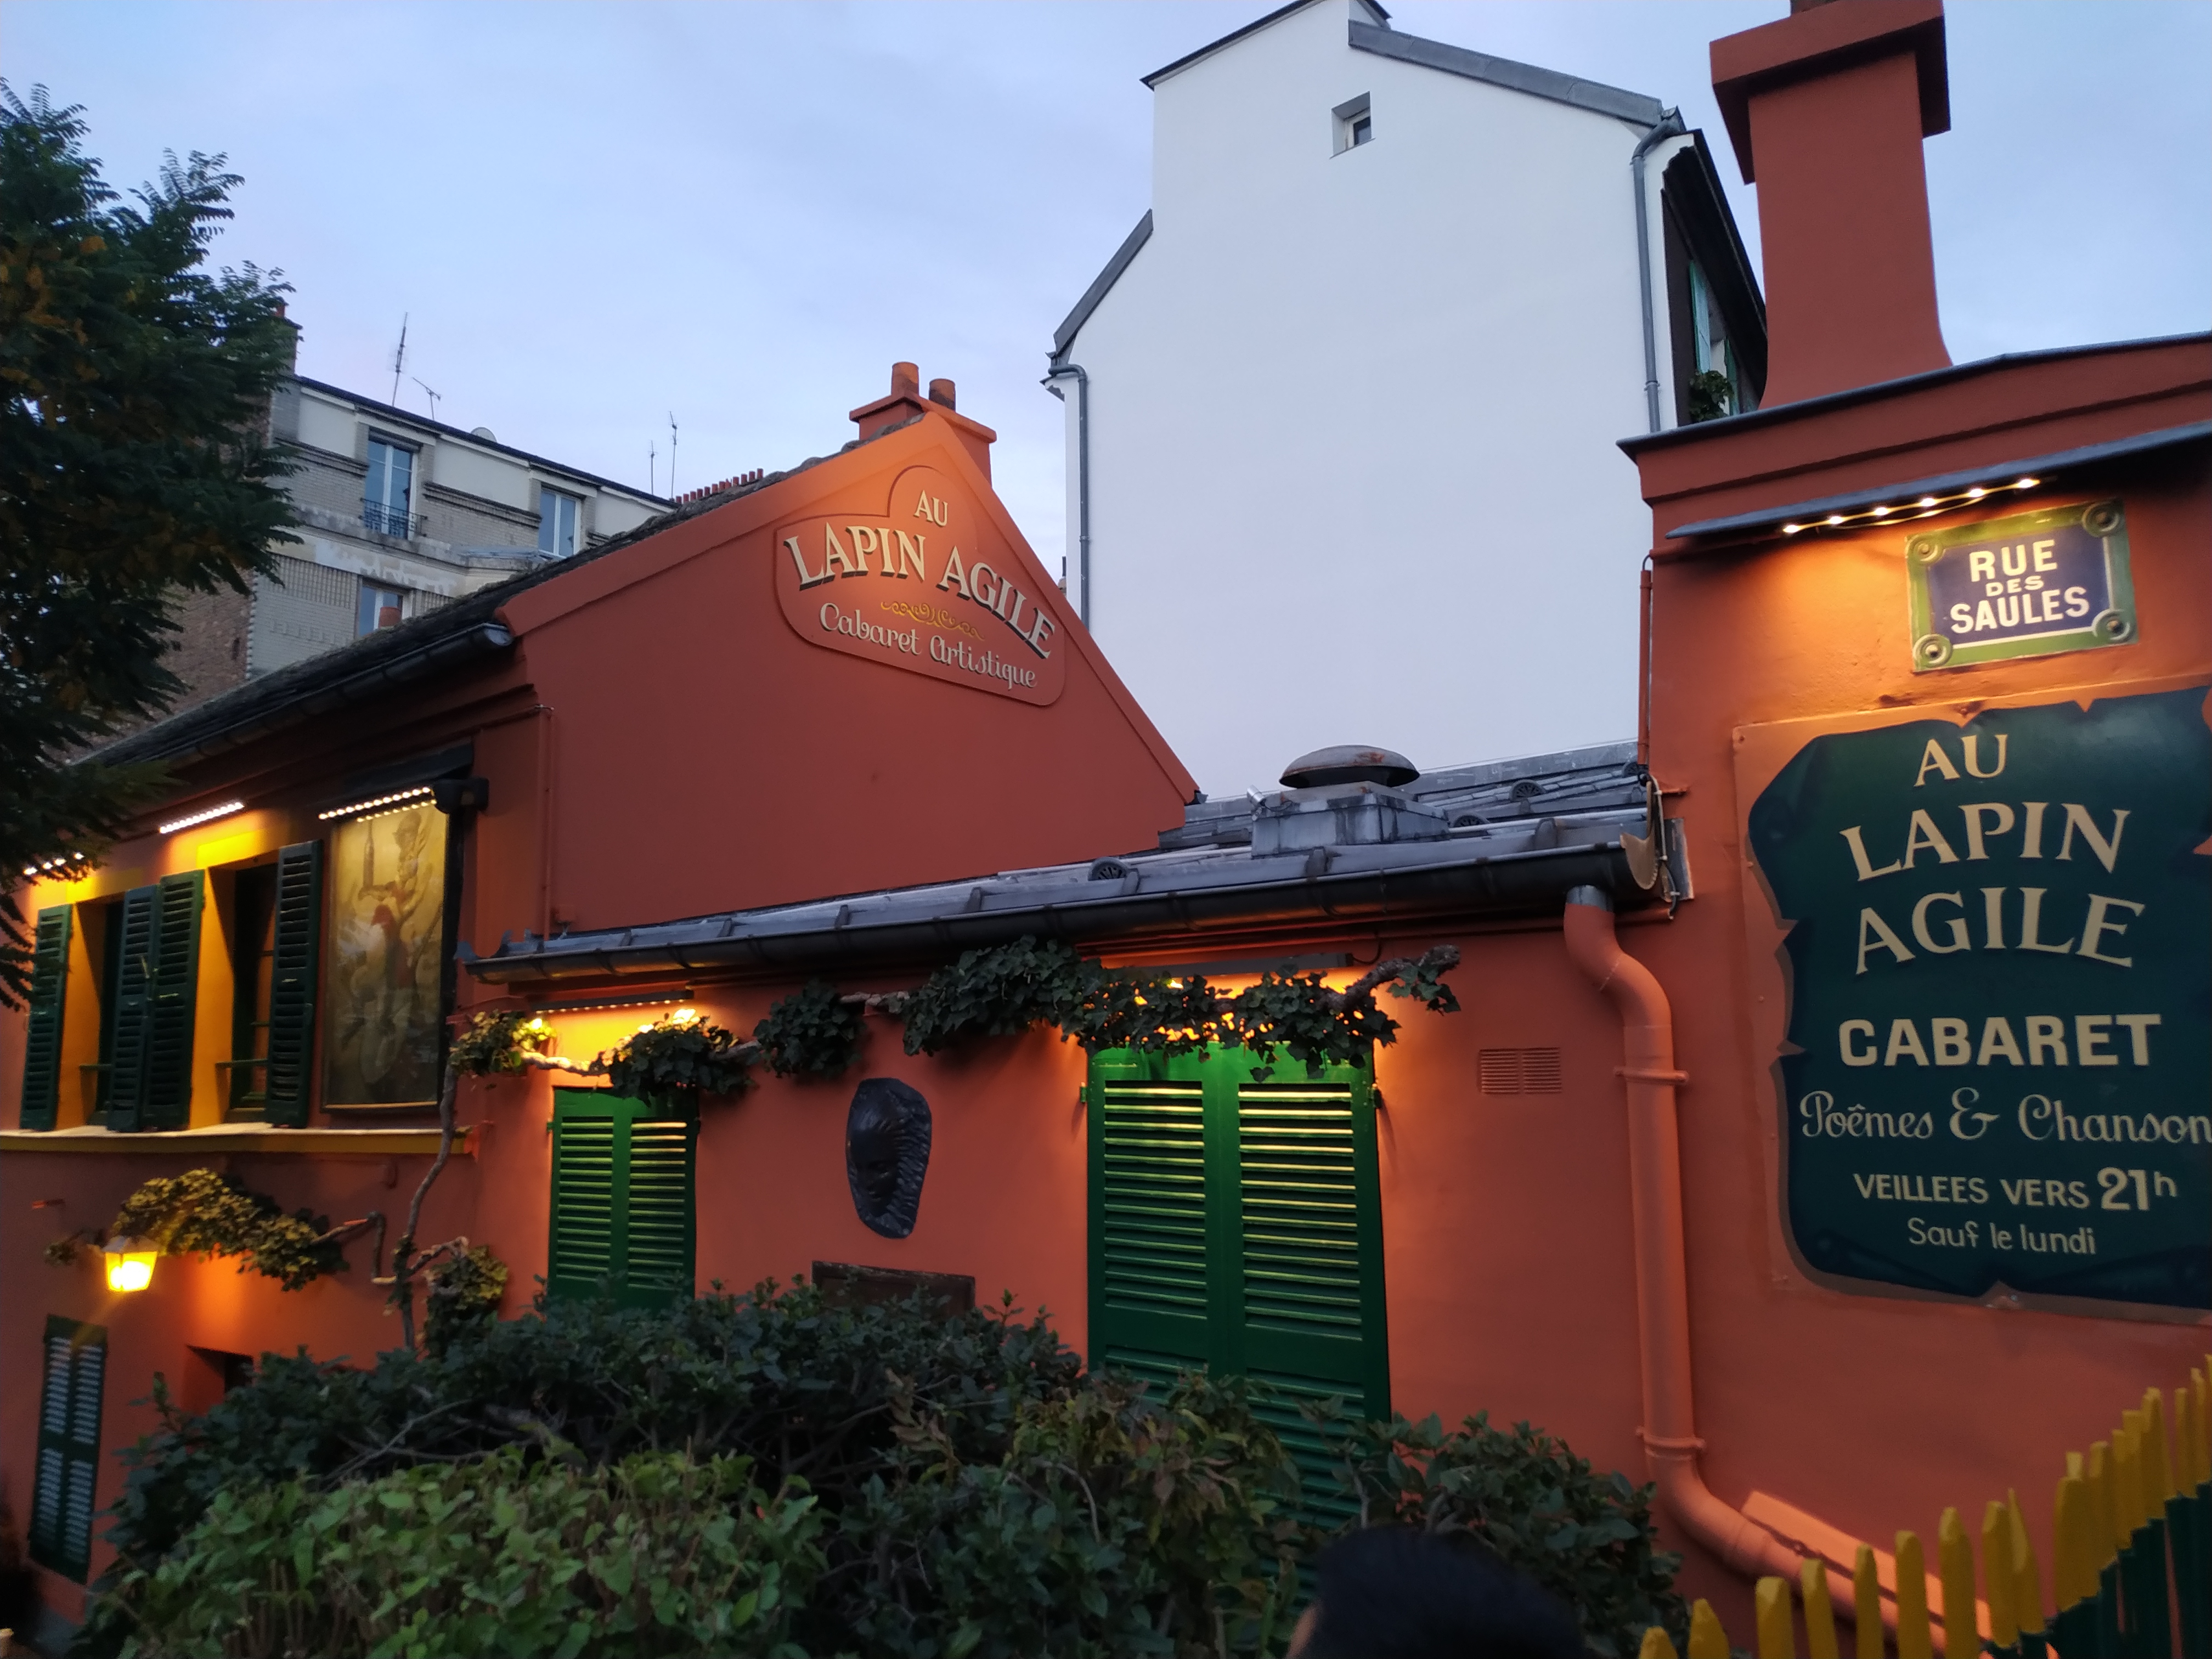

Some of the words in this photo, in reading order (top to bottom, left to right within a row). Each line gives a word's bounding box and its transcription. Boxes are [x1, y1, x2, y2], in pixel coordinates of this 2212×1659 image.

[914, 489, 949, 527] AU
[1969, 539, 2058, 583] RUE
[1985, 575, 2044, 597] DES
[783, 522, 927, 591] LAPIN
[936, 545, 1056, 659] AGILE
[1950, 586, 2090, 634] SAULES
[820, 602, 922, 655] Cabaret
[1913, 733, 2008, 787] AU
[1839, 801, 2131, 882] LAPIN
[1855, 886, 2146, 975] AGILE
[1838, 1014, 2162, 1066] CABARET
[1799, 1090, 1933, 1138] Poêmes
[1949, 1087, 2000, 1140] &
[1853, 1173, 1989, 1205] VEILLEES
[2000, 1178, 2090, 1209] VERS
[2096, 1167, 2178, 1211] 21h
[1907, 1217, 1979, 1248] Sauf
[1989, 1222, 2013, 1250] le
[2019, 1224, 2097, 1255] lundi
